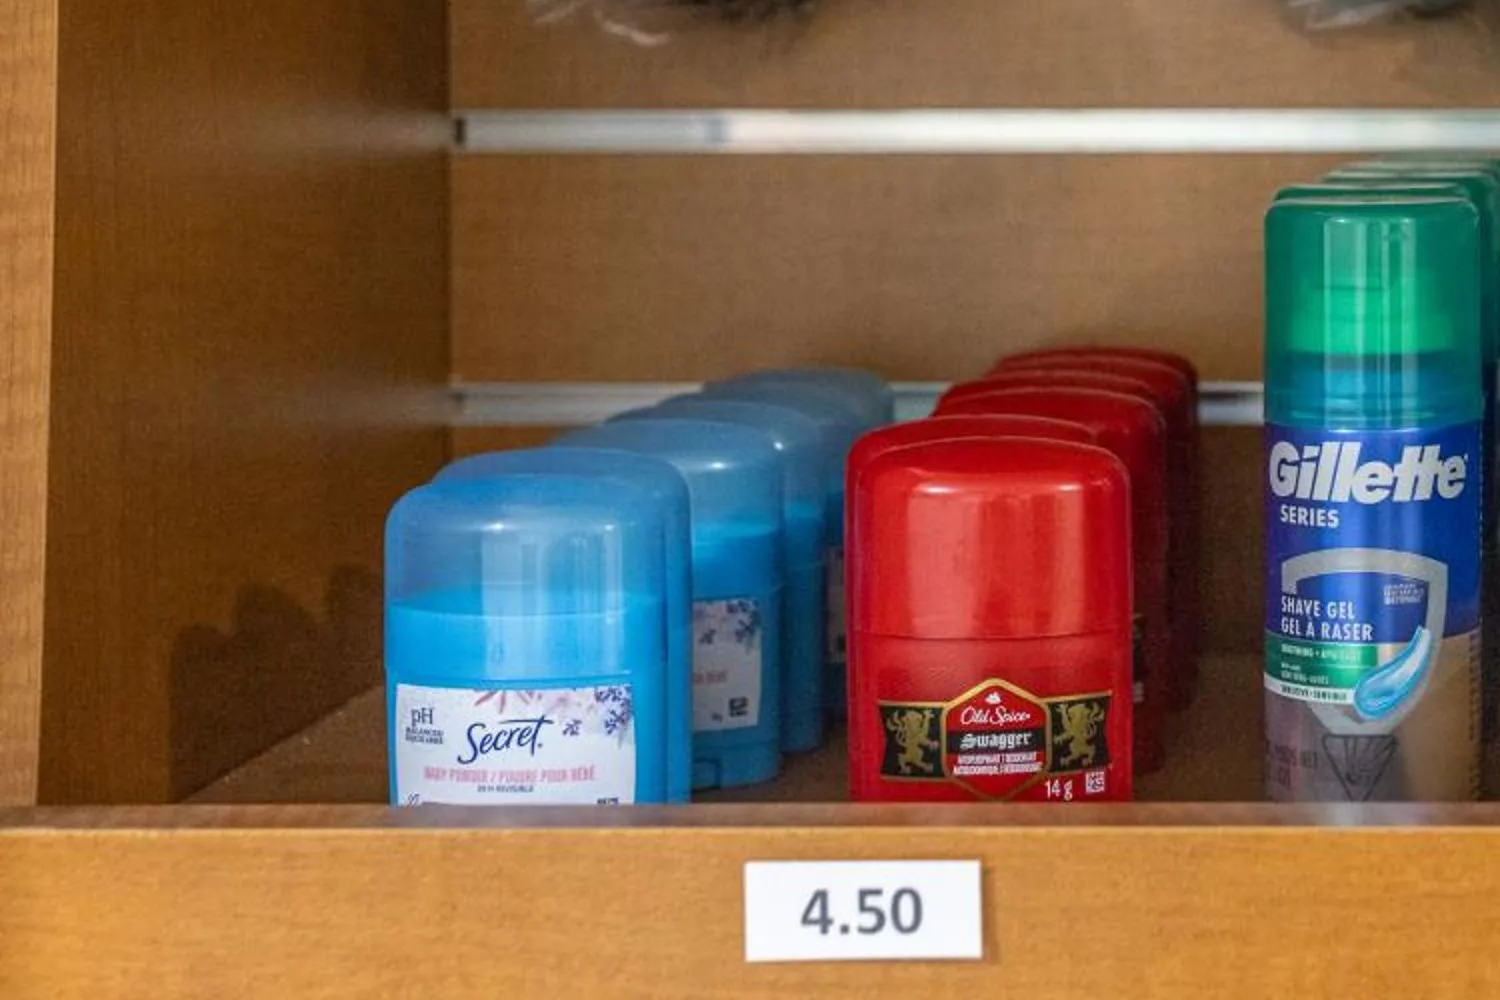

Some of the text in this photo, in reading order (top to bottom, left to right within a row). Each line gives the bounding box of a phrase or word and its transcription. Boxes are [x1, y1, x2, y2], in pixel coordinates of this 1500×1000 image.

[1269, 441, 1467, 504] Gillette
[1280, 505, 1340, 529] SERIES
[1281, 596, 1356, 620] SHAVE GEL
[1281, 618, 1301, 635] GEL
[1321, 623, 1373, 641] RASER
[411, 707, 434, 725] pH
[961, 706, 1028, 727] Old Spice
[457, 715, 554, 765] Secret
[961, 731, 1032, 750] Swagger
[1044, 780, 1060, 797] 14
[801, 887, 923, 935] 4.50
